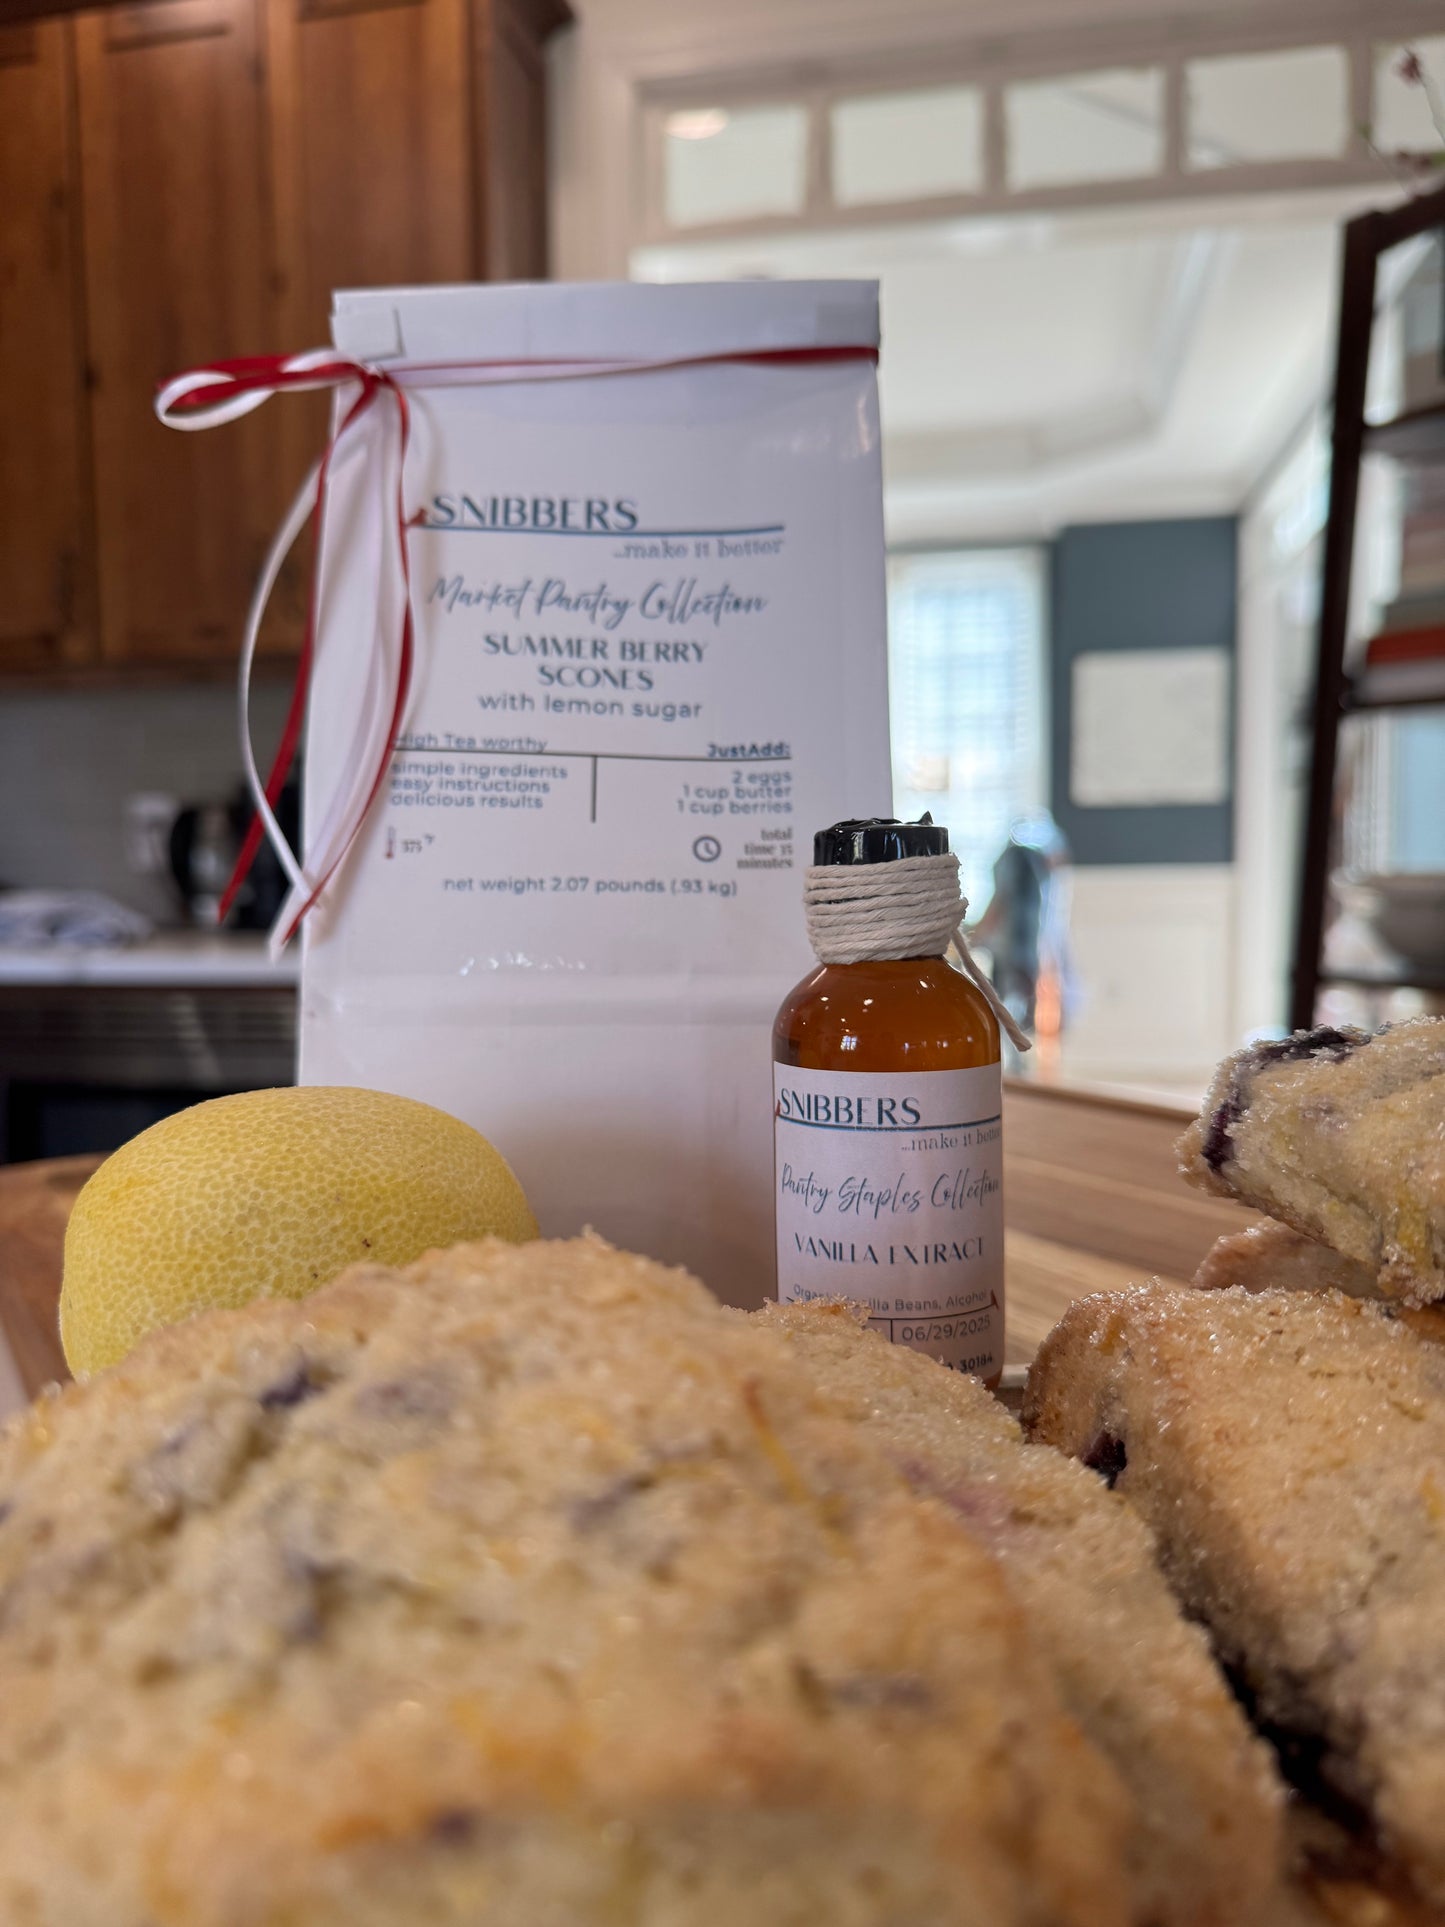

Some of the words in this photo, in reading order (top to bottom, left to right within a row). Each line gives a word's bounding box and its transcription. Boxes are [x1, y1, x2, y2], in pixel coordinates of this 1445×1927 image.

[431, 494, 639, 530] SNIBBERS
[698, 538, 711, 558] it
[717, 536, 784, 558] better
[427, 575, 533, 620] Market
[534, 578, 635, 631] Pantry
[638, 578, 767, 626] Collection
[483, 632, 609, 661] SUMMER
[619, 639, 709, 664] BERRY
[538, 664, 655, 691] SCONES
[478, 692, 535, 712] with
[543, 694, 624, 717] lemon
[632, 700, 703, 722] sugar
[444, 734, 477, 751] Tea
[482, 737, 548, 754] worthy
[391, 762, 455, 777] simple
[460, 762, 568, 780] ingredients
[732, 770, 742, 785] 2
[746, 771, 793, 787] eggs
[391, 777, 433, 793] easy
[438, 778, 551, 793] instructions
[683, 783, 690, 798] 1
[694, 787, 730, 801] cup
[734, 785, 792, 800] butter
[390, 792, 475, 807] delicious
[480, 794, 544, 809] results
[677, 798, 685, 814] 1
[689, 802, 725, 816] cup
[729, 800, 793, 815] berries
[443, 876, 474, 892] net
[480, 877, 545, 895] weight
[551, 877, 590, 892] 2.07
[595, 876, 665, 894] pounds
[708, 879, 738, 898] kg)
[780, 1087, 921, 1126] SNIBBERS
[963, 1132, 971, 1147] it
[781, 1162, 832, 1214] Pantry
[838, 1172, 924, 1219] Staples
[930, 1167, 999, 1210] Collection
[794, 1231, 878, 1265] VANILLA
[889, 1236, 984, 1265] EXTRACT
[895, 1298, 942, 1312] Beans,
[902, 1315, 991, 1342] 06/29/2025
